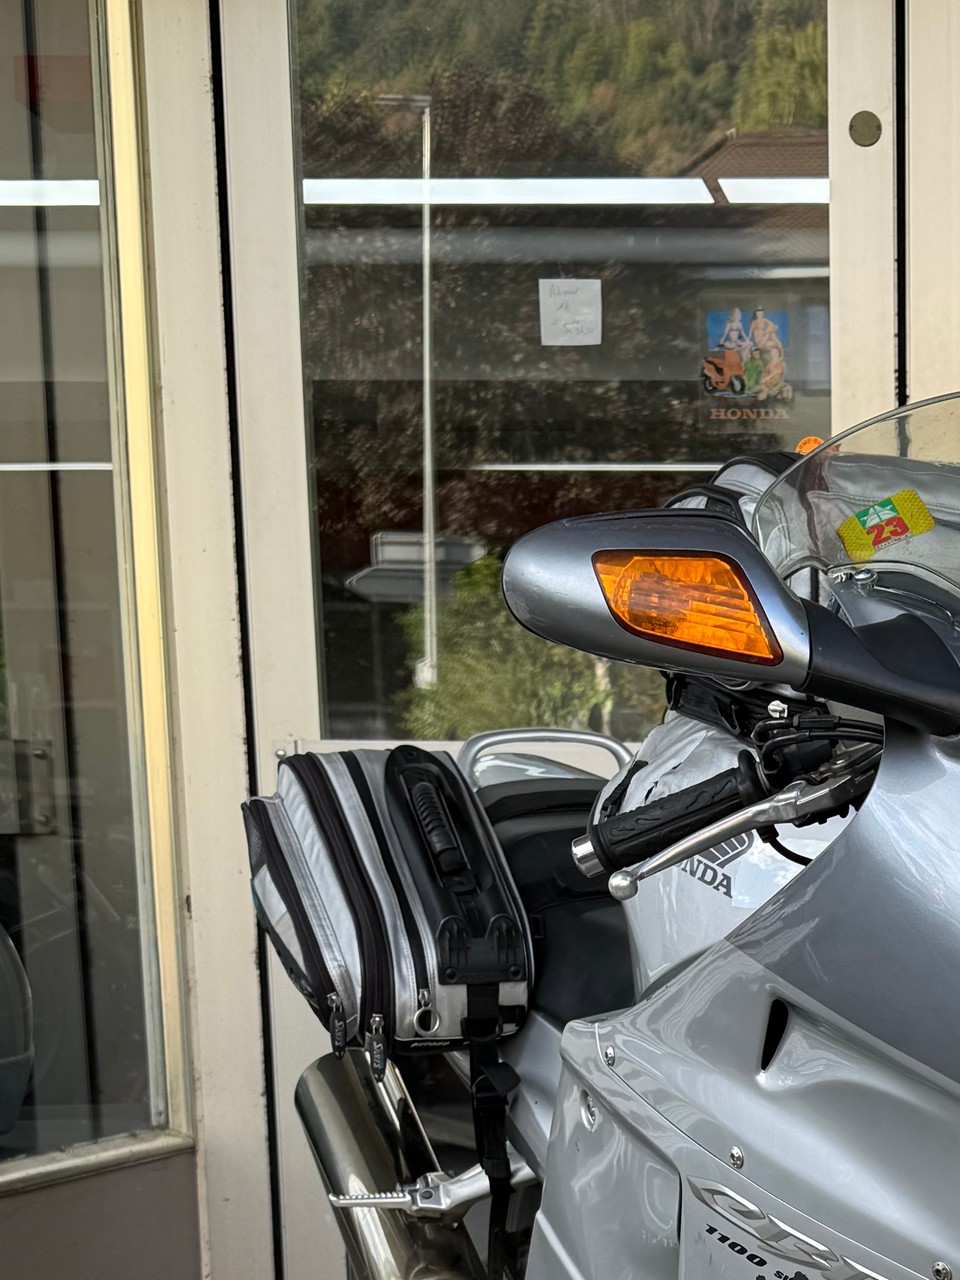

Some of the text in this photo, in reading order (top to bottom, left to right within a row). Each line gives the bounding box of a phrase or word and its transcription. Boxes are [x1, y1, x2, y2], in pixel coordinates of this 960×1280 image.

[709, 408, 791, 420] HONDA
[866, 516, 910, 547] 23
[705, 1223, 768, 1268] 1100
